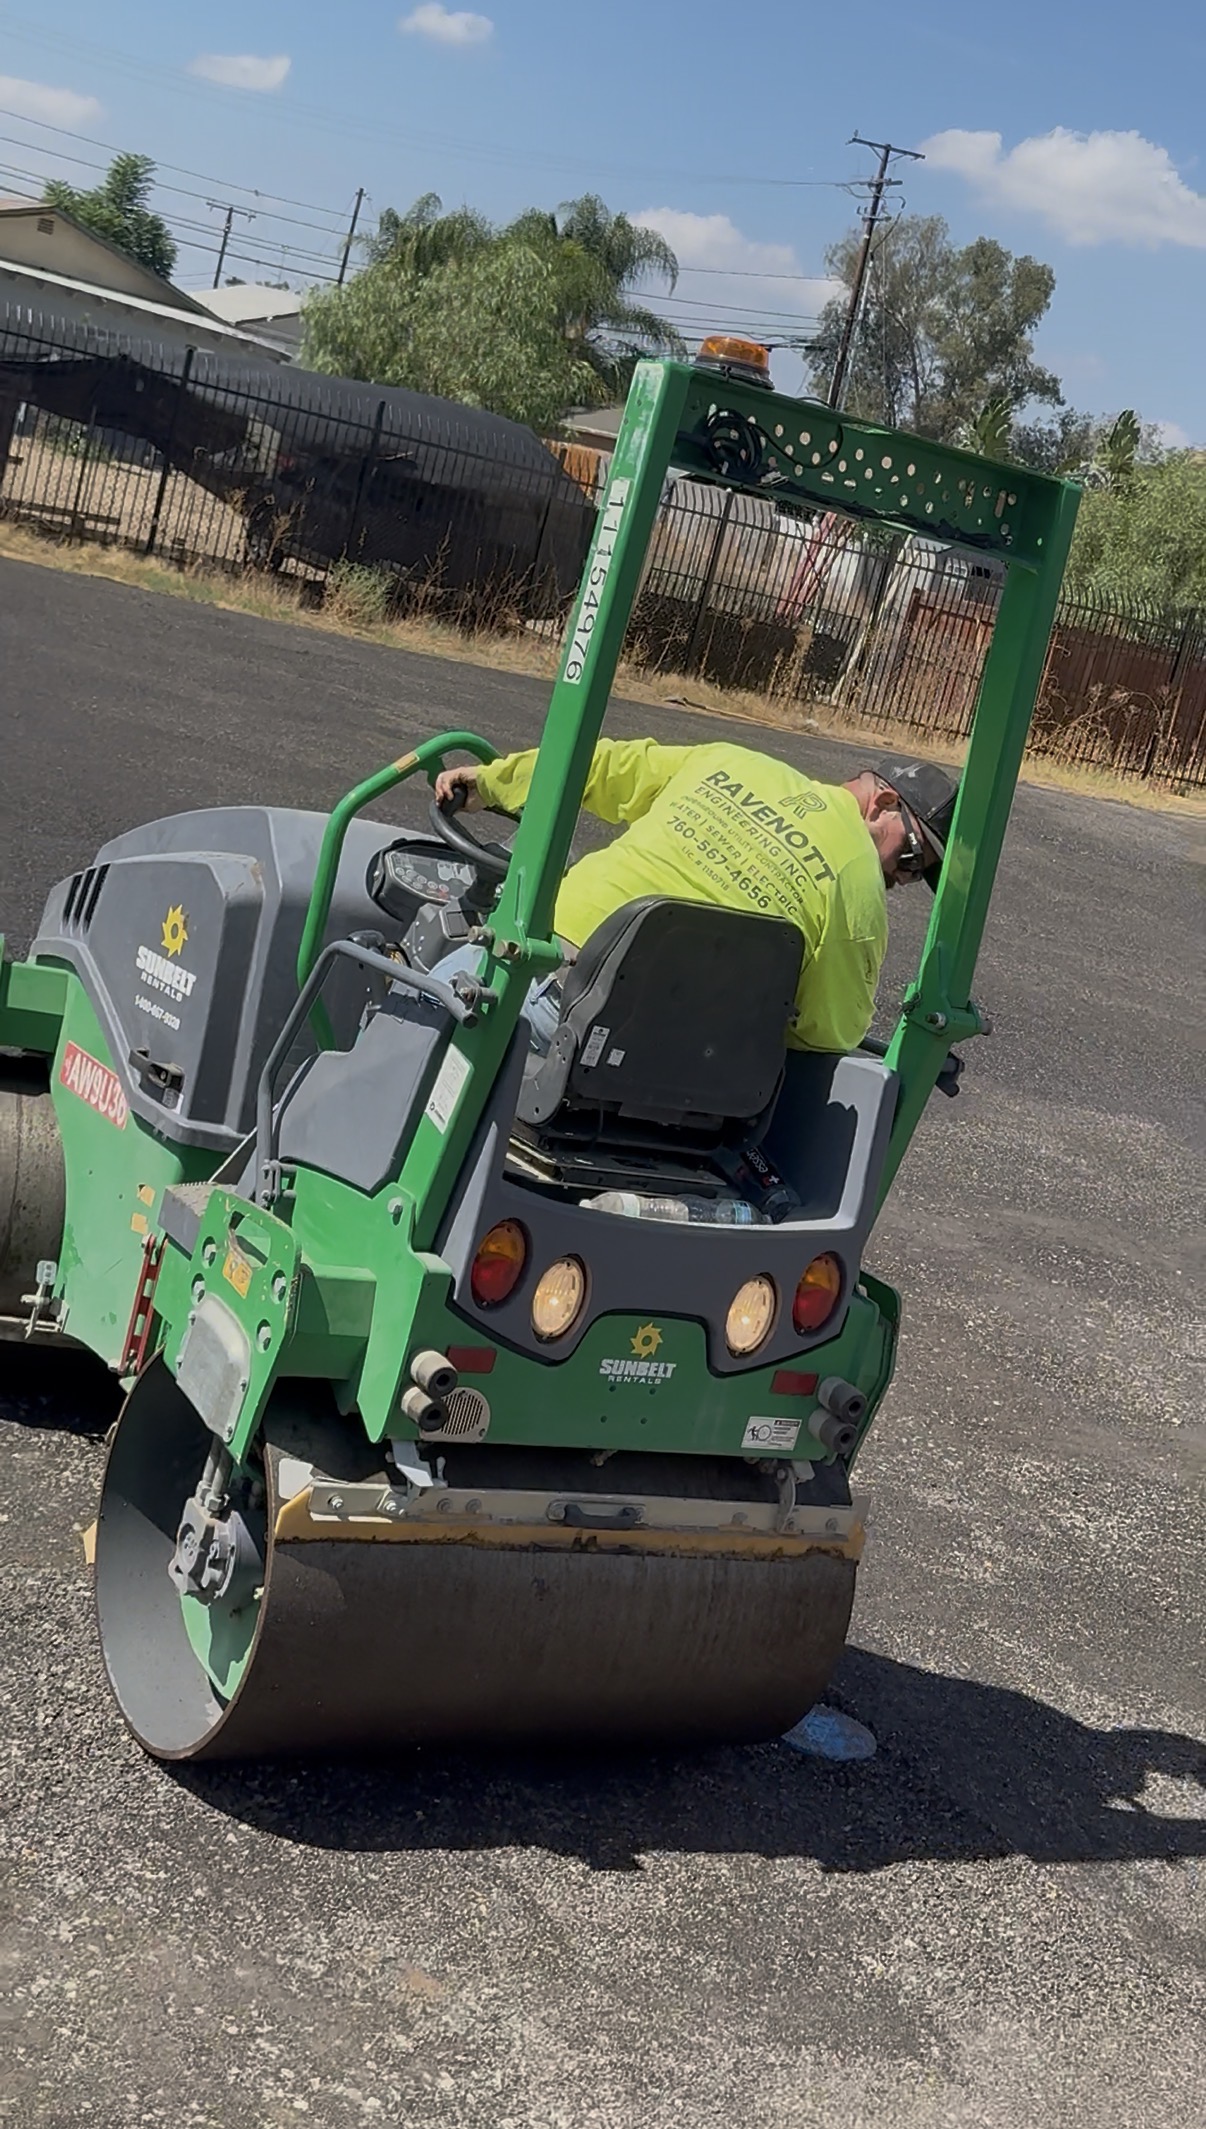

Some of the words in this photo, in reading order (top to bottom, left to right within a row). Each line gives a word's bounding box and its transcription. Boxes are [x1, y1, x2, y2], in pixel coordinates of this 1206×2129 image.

[666, 815, 772, 909] 760-567-4656
[694, 786, 781, 857] ENGINEERING
[780, 858, 807, 892] INC.
[705, 770, 836, 882] RAVENOTT
[705, 824, 742, 859] SEWER
[747, 863, 797, 916] ELECTRIC
[727, 828, 753, 853] UTILITY
[755, 853, 804, 905] CONTRACTOR
[135, 945, 197, 997] SUNBELT
[140, 971, 183, 1003] RENTALS
[599, 1358, 677, 1378] SUNBELT
[607, 1375, 662, 1385] RENTALS
